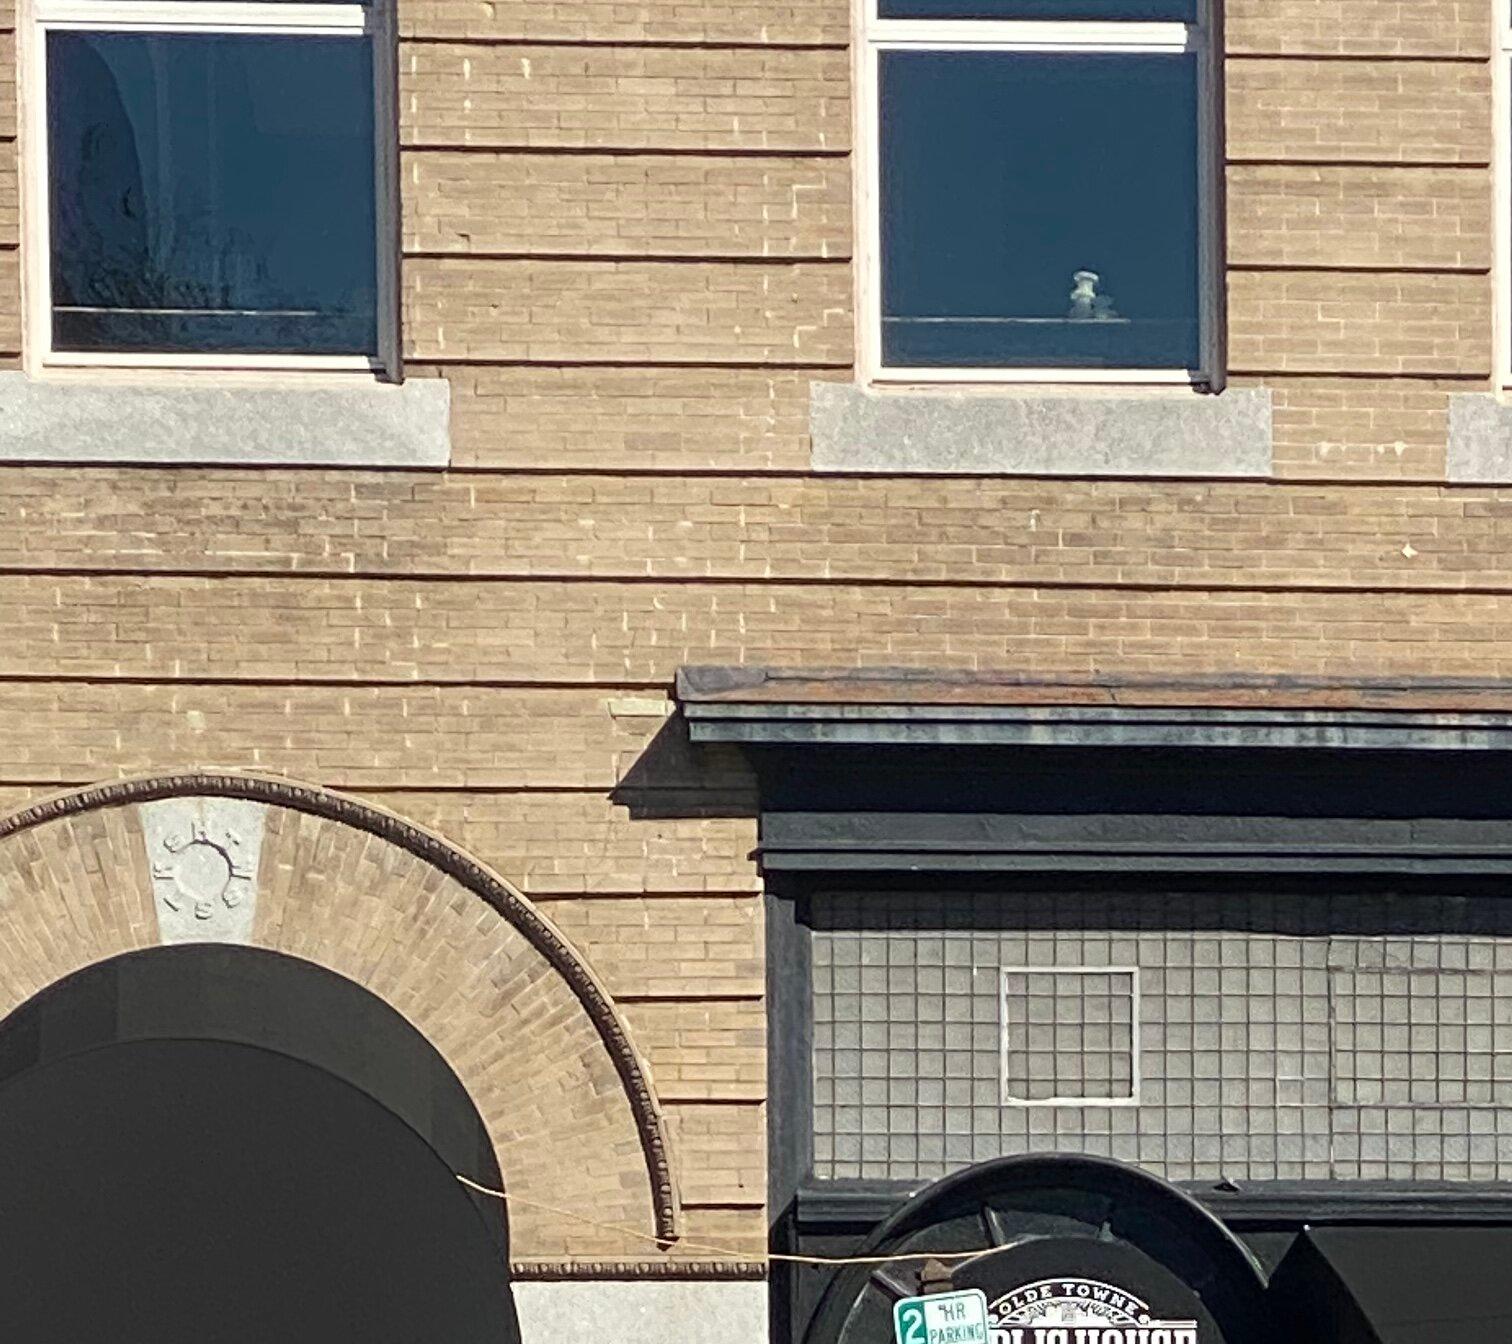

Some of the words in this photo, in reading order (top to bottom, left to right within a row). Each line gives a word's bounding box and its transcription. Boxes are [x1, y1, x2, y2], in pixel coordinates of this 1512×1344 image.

[999, 1285, 1052, 1314] OLDE
[1064, 1284, 1137, 1314] TOWNE
[943, 1303, 966, 1321] HR
